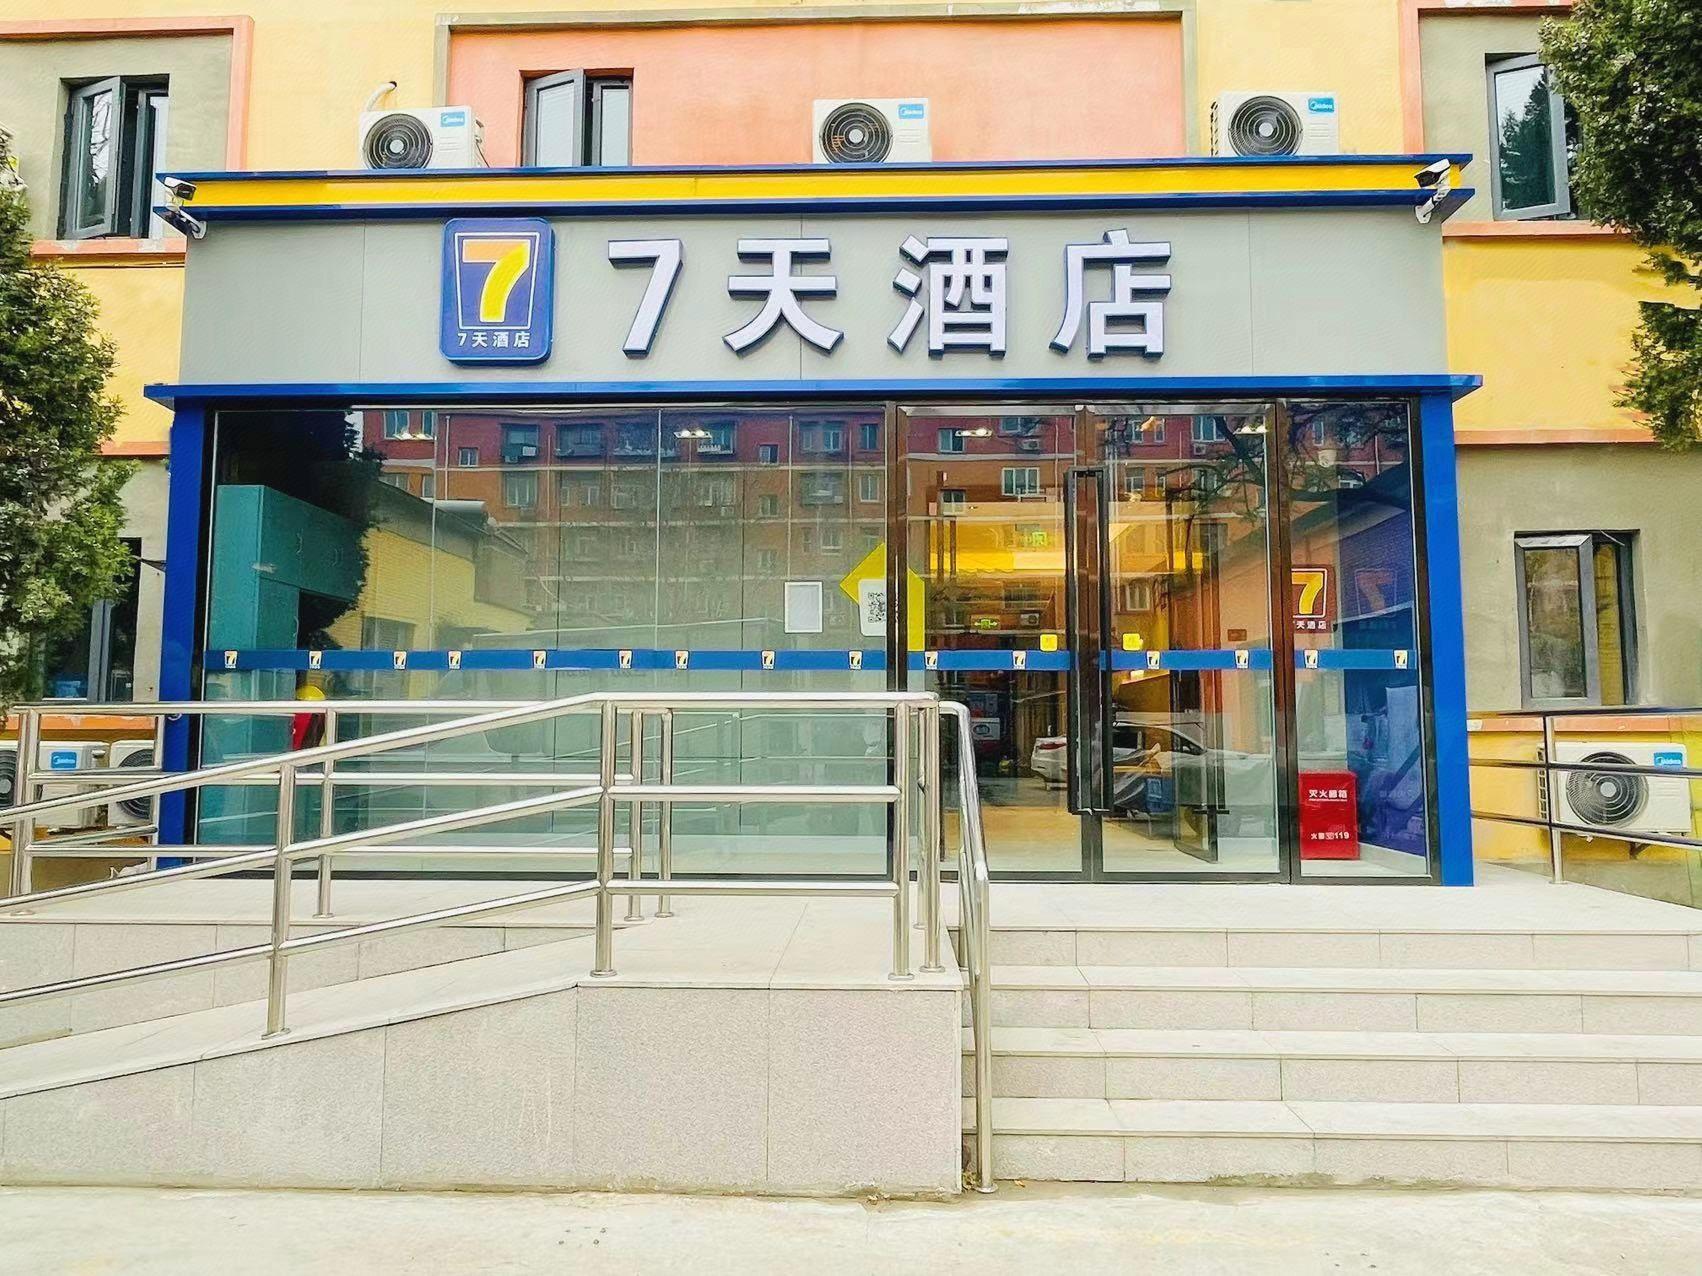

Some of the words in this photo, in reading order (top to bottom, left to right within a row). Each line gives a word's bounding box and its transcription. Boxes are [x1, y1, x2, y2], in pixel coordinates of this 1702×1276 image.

[463, 239, 531, 323] 7
[607, 228, 1172, 359] 7天酒店
[457, 331, 531, 348] 7天酒店
[1291, 572, 1324, 615] 7
[1293, 621, 1327, 630] 天酒店
